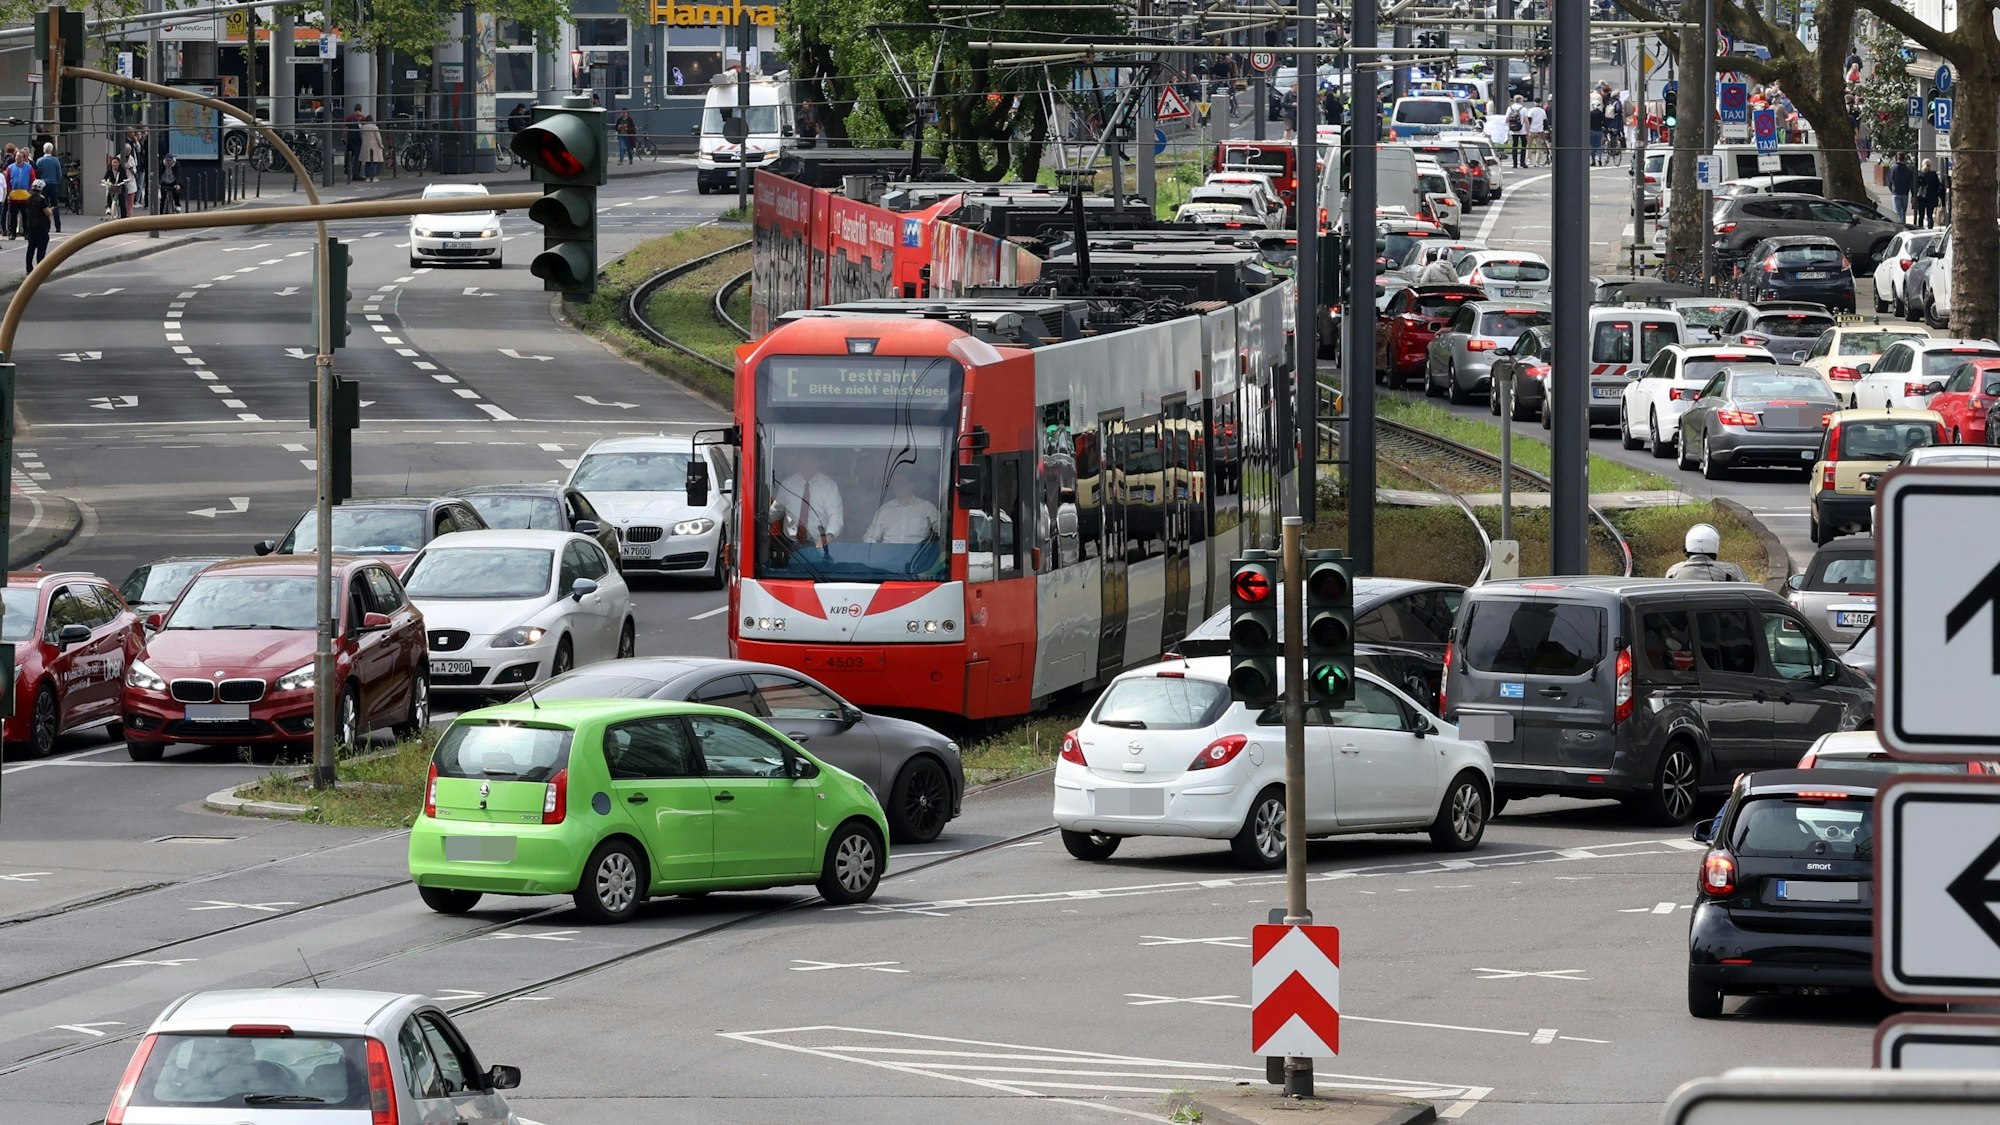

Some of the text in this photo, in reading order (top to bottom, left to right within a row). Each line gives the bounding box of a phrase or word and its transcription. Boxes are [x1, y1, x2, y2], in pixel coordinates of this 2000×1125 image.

[1256, 54, 1270, 64] 30
[1910, 98, 1919, 114] P
[1723, 110, 1744, 119] TAXI
[1938, 103, 1948, 126] P
[1758, 140, 1776, 150] TAXI
[787, 368, 917, 398] E Testfahrt
[808, 384, 947, 397] Bitte nicht einsteigen
[830, 606, 848, 614] KVB
[1843, 614, 1868, 624] K AB
[448, 662, 470, 672] 2900
[826, 657, 864, 668] 4503
[103, 658, 120, 682] Uber
